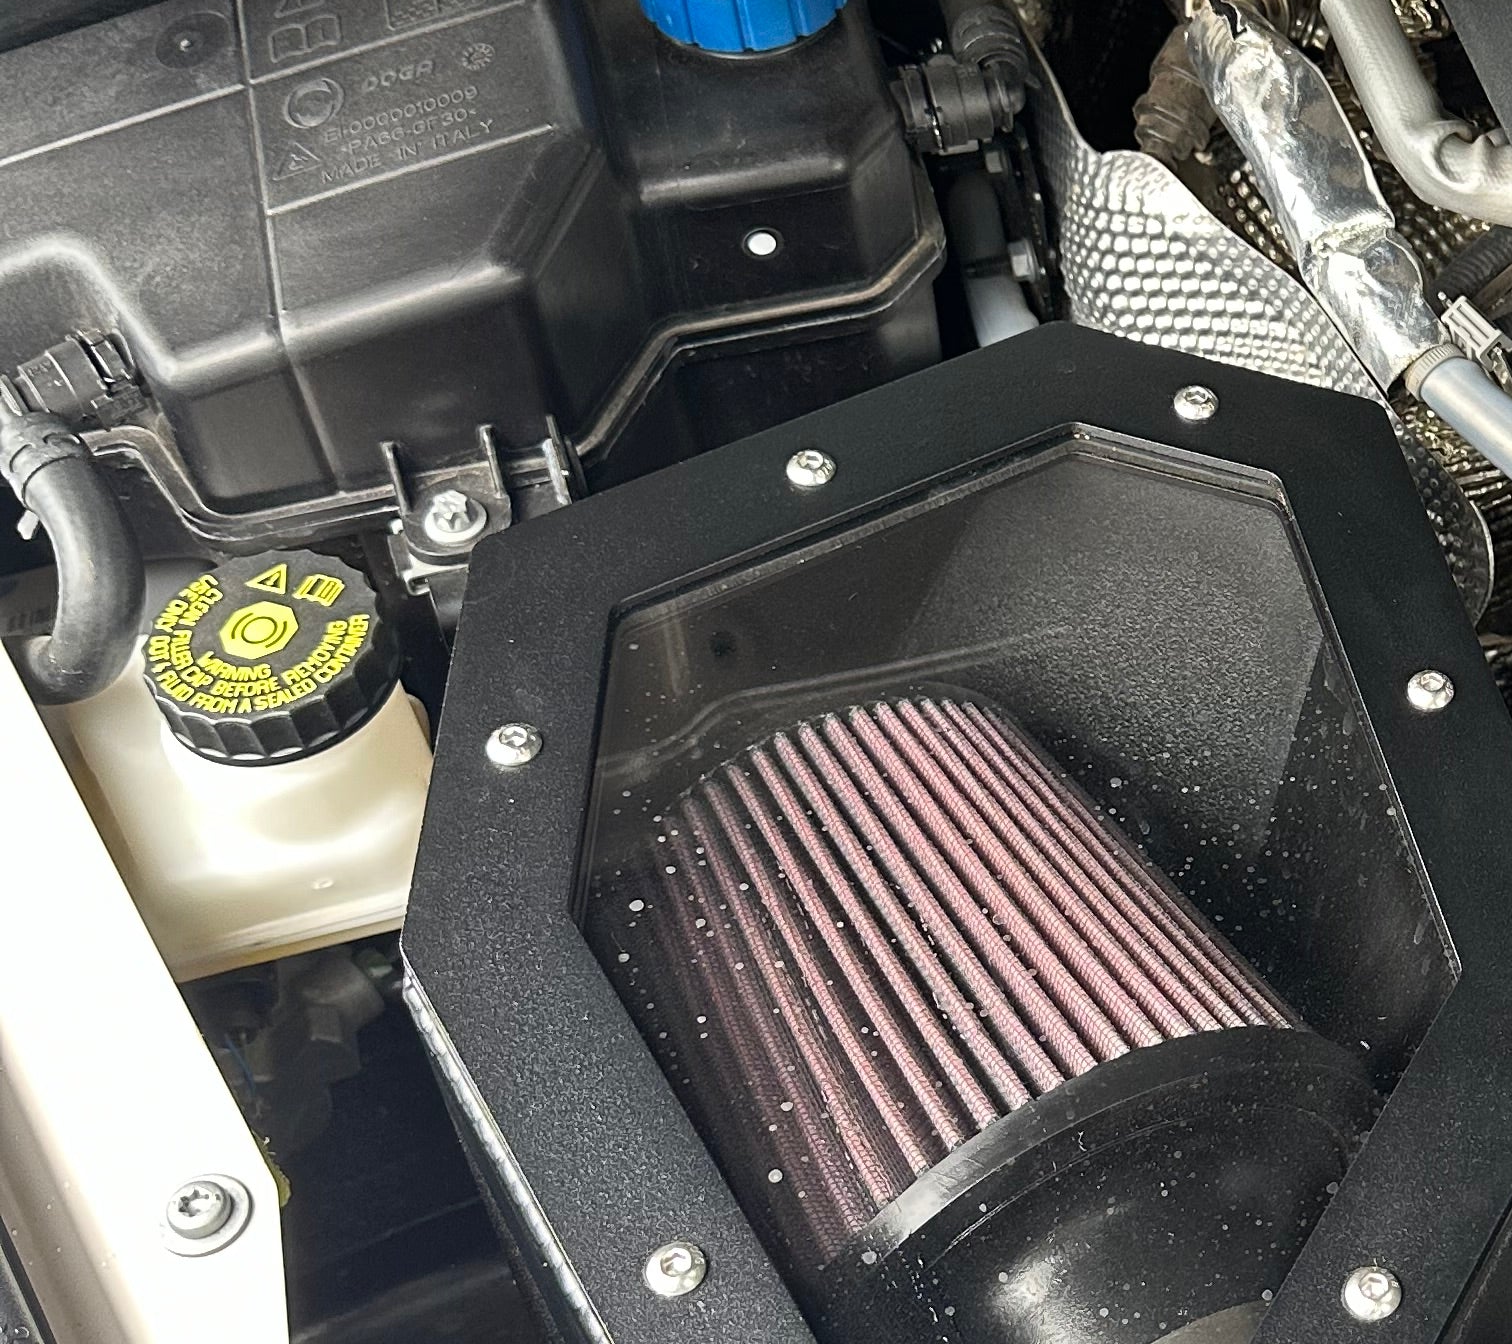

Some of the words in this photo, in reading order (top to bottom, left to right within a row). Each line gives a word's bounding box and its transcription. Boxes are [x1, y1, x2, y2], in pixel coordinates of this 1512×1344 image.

[320, 154, 382, 185] MADE
[432, 119, 493, 151] ITALY
[177, 573, 219, 599] USE
[179, 587, 223, 627] CLEAN
[148, 635, 171, 663] DOT
[169, 629, 193, 672] FILLER
[281, 619, 348, 686] REMOVING
[313, 613, 370, 684] CONTAINER
[181, 667, 214, 688] CAP
[196, 650, 271, 681] WARNING
[210, 676, 282, 697] BEFORE
[252, 678, 318, 711] SEALED
[188, 694, 238, 714] FROM
[238, 697, 252, 714] A
